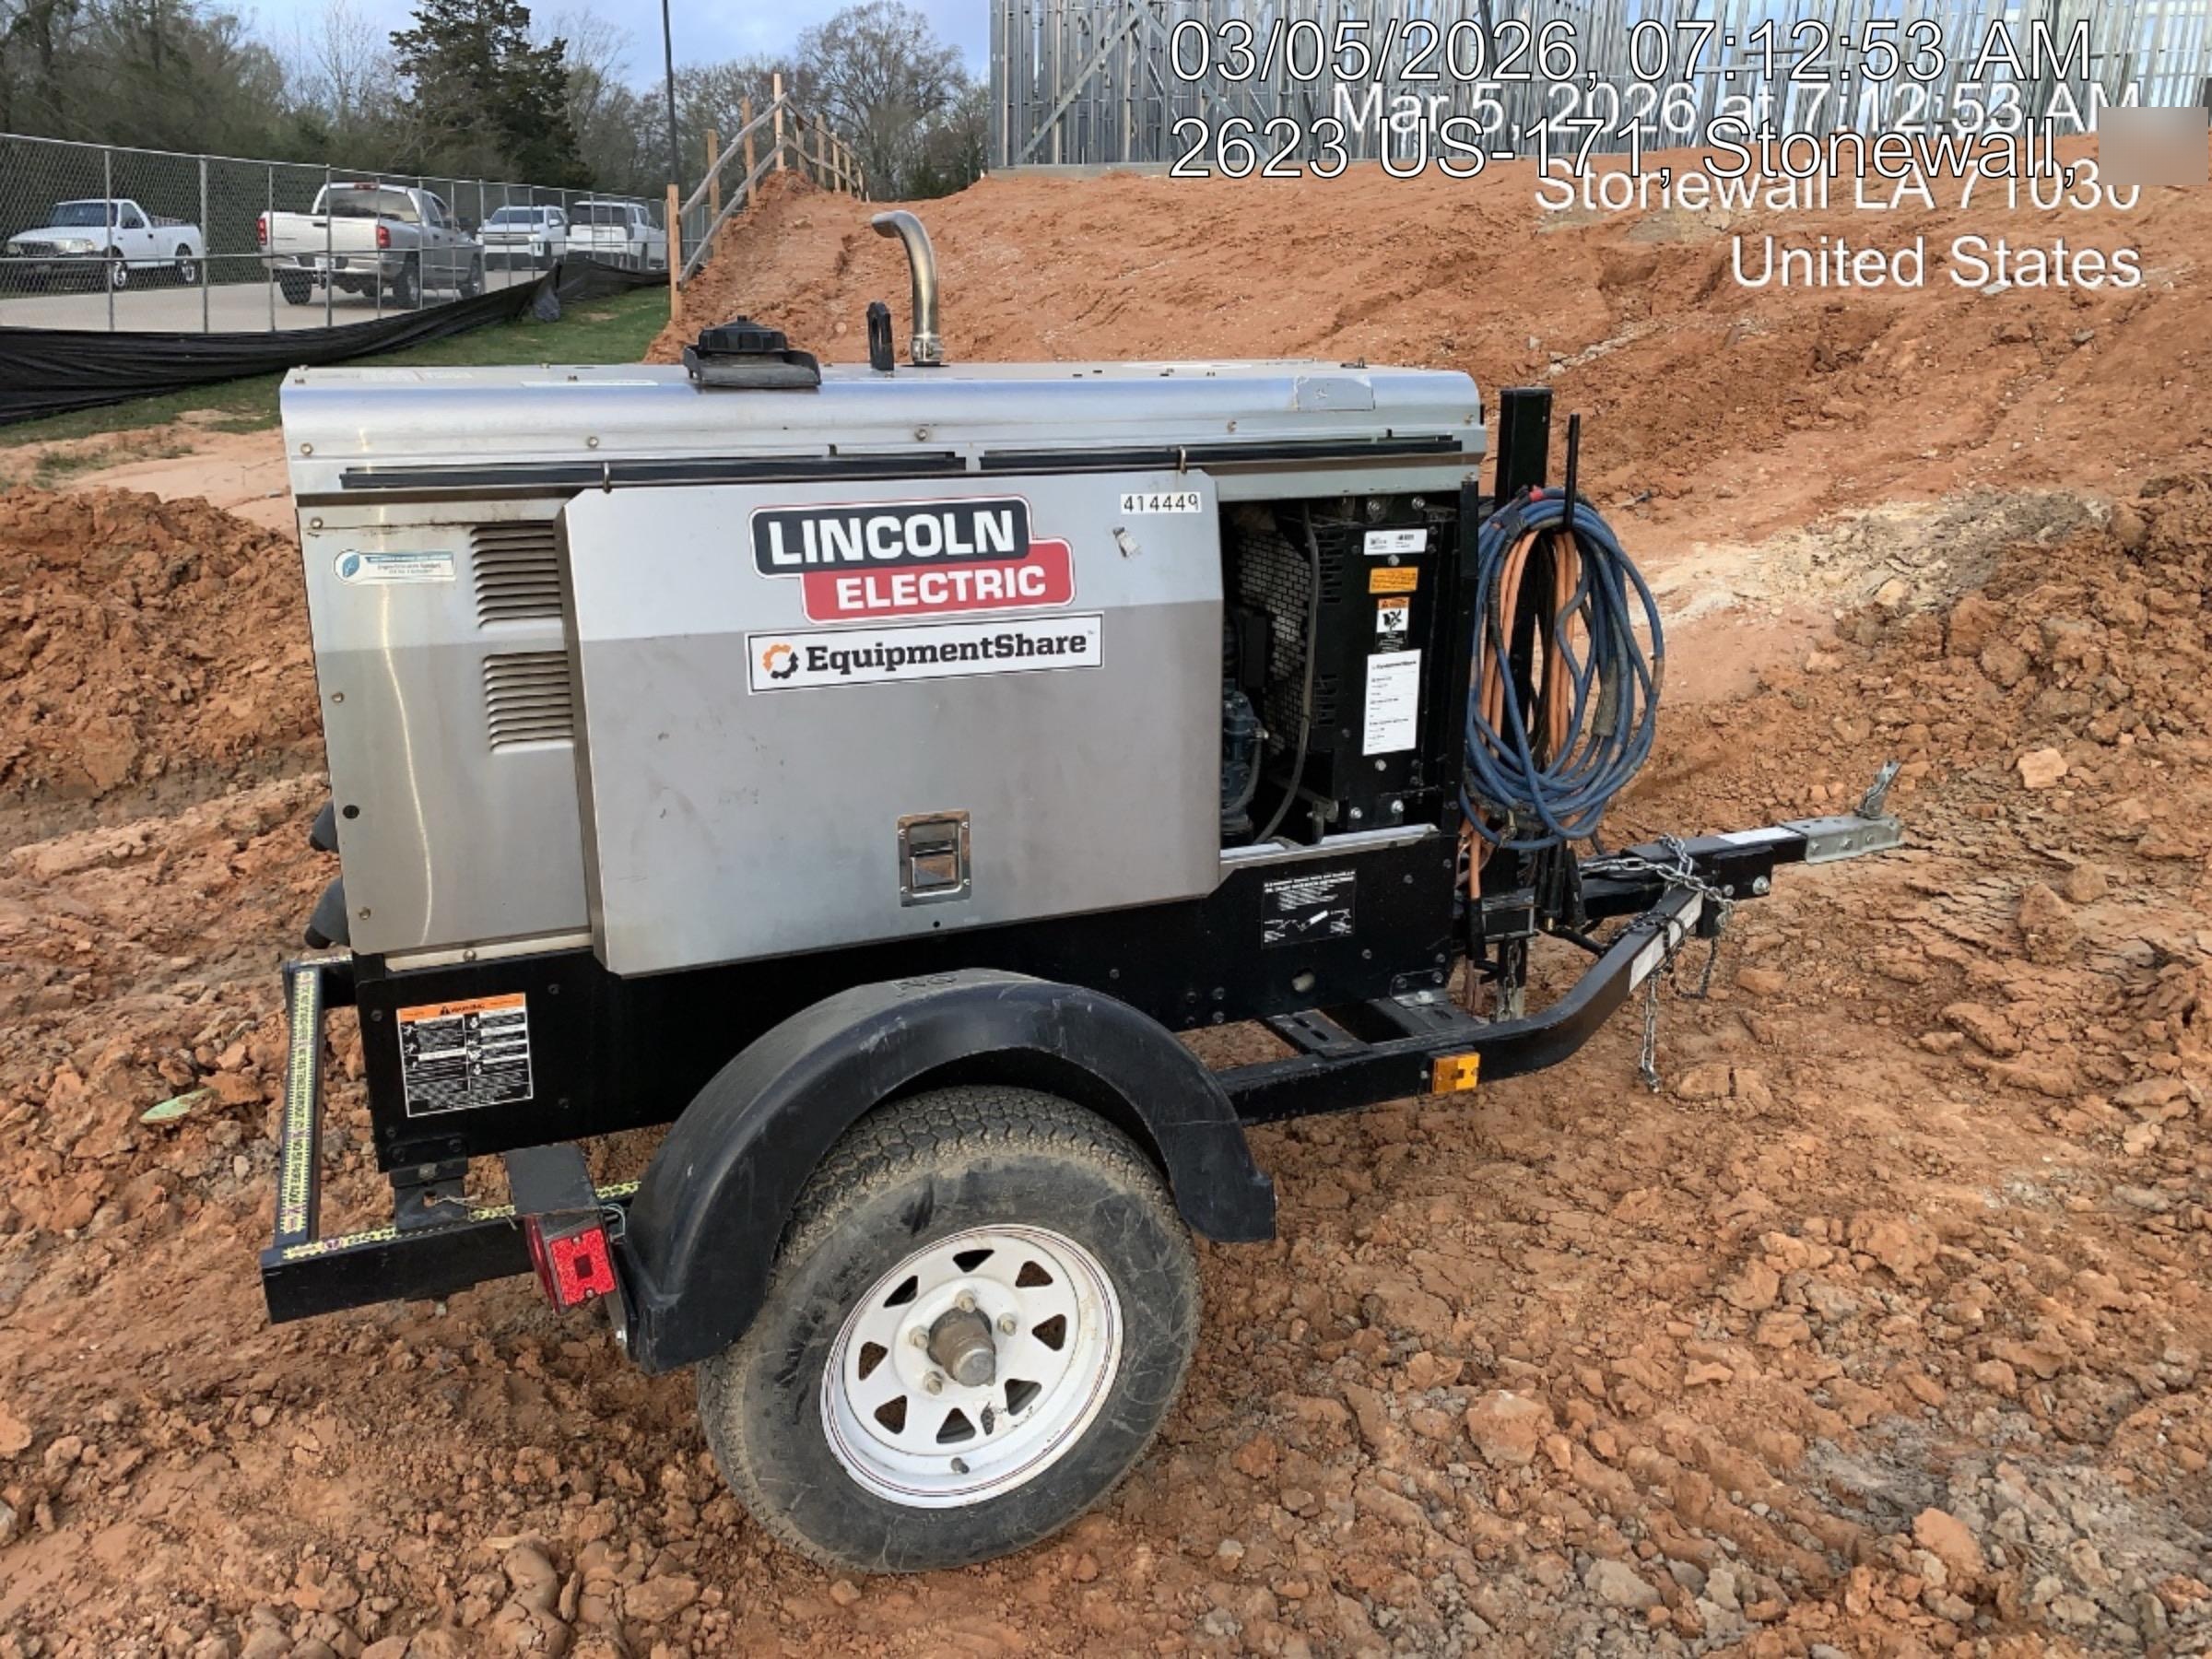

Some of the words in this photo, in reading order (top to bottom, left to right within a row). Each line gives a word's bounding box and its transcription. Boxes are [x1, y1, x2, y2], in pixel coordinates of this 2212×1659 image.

[1123, 492, 1199, 513] 414449
[767, 509, 1014, 566] LINCOLN
[835, 564, 1047, 611] ELECTRIC
[806, 632, 1088, 676] EquipmentShare
